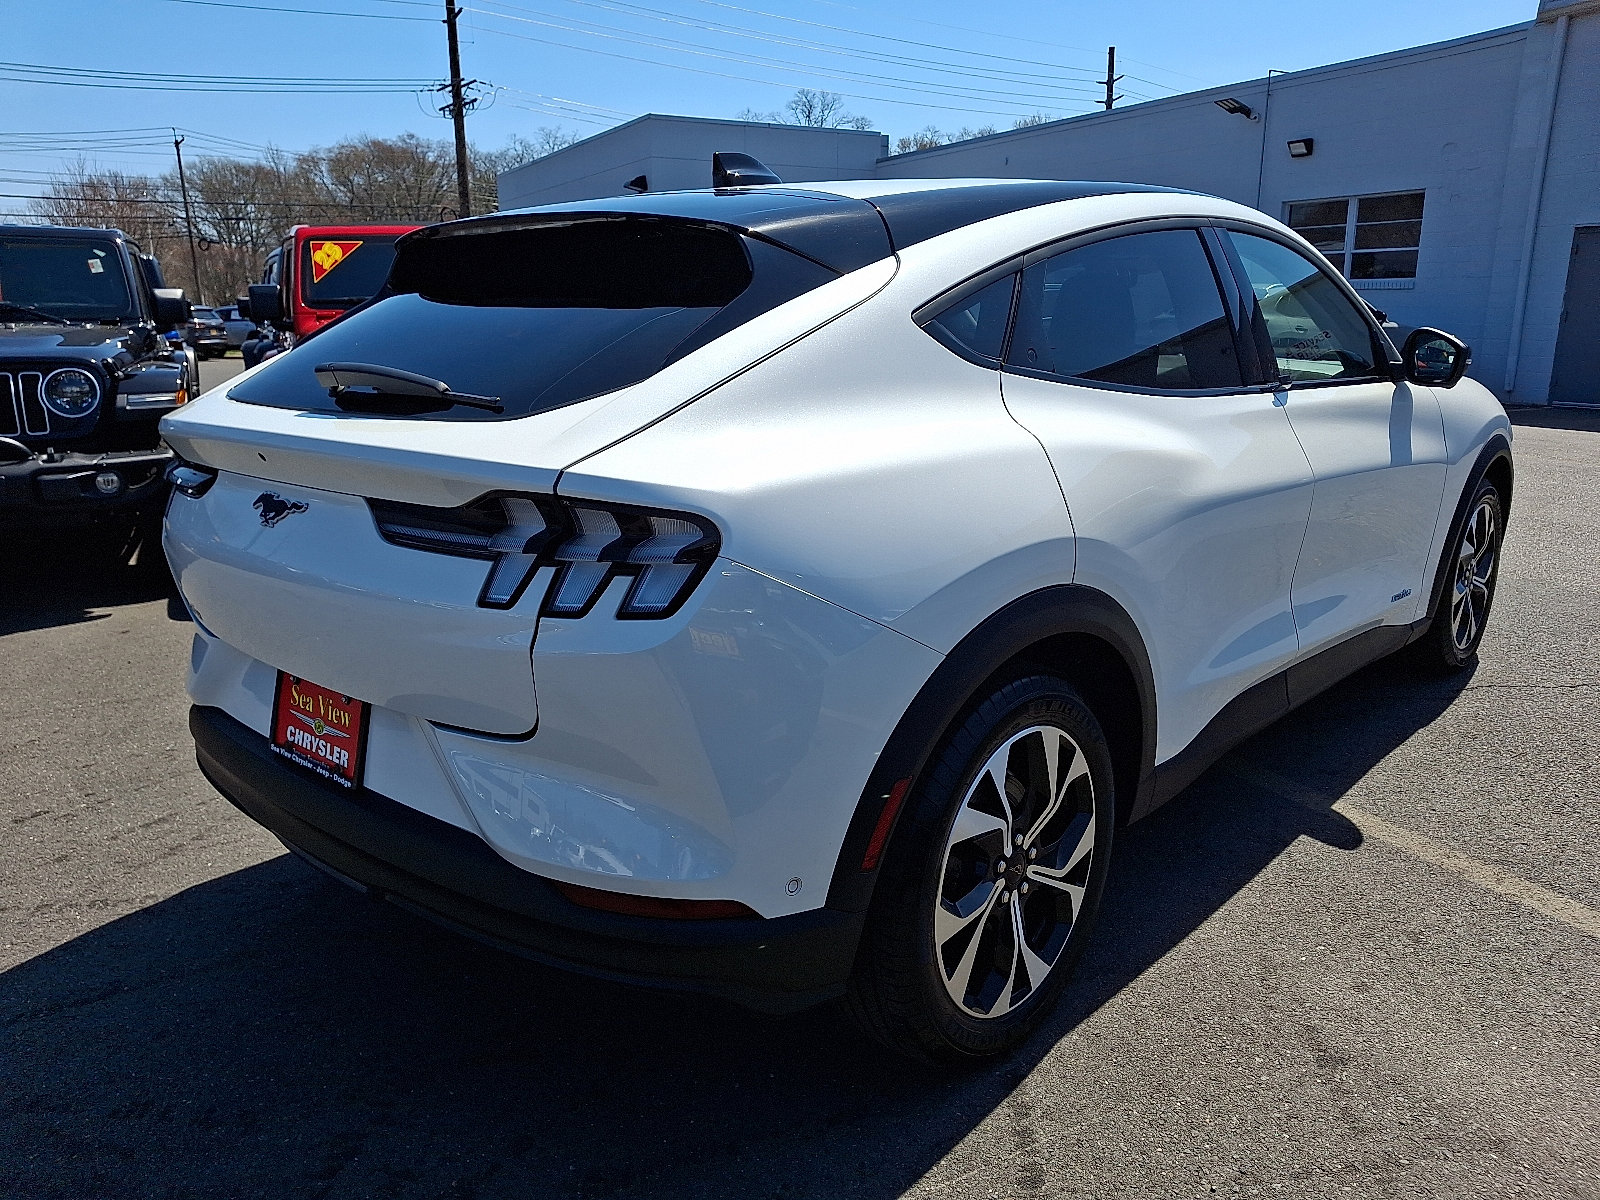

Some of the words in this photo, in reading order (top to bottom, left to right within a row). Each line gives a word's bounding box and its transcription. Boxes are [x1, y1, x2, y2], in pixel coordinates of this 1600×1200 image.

[290, 684, 313, 712] Sea
[318, 694, 352, 727] View
[270, 743, 280, 753] Sea
[280, 747, 292, 758] View
[291, 753, 314, 769] Chrysler
[316, 765, 330, 777] Jeep
[333, 773, 352, 788] Dodge
[286, 725, 349, 768] CHRYSLER
